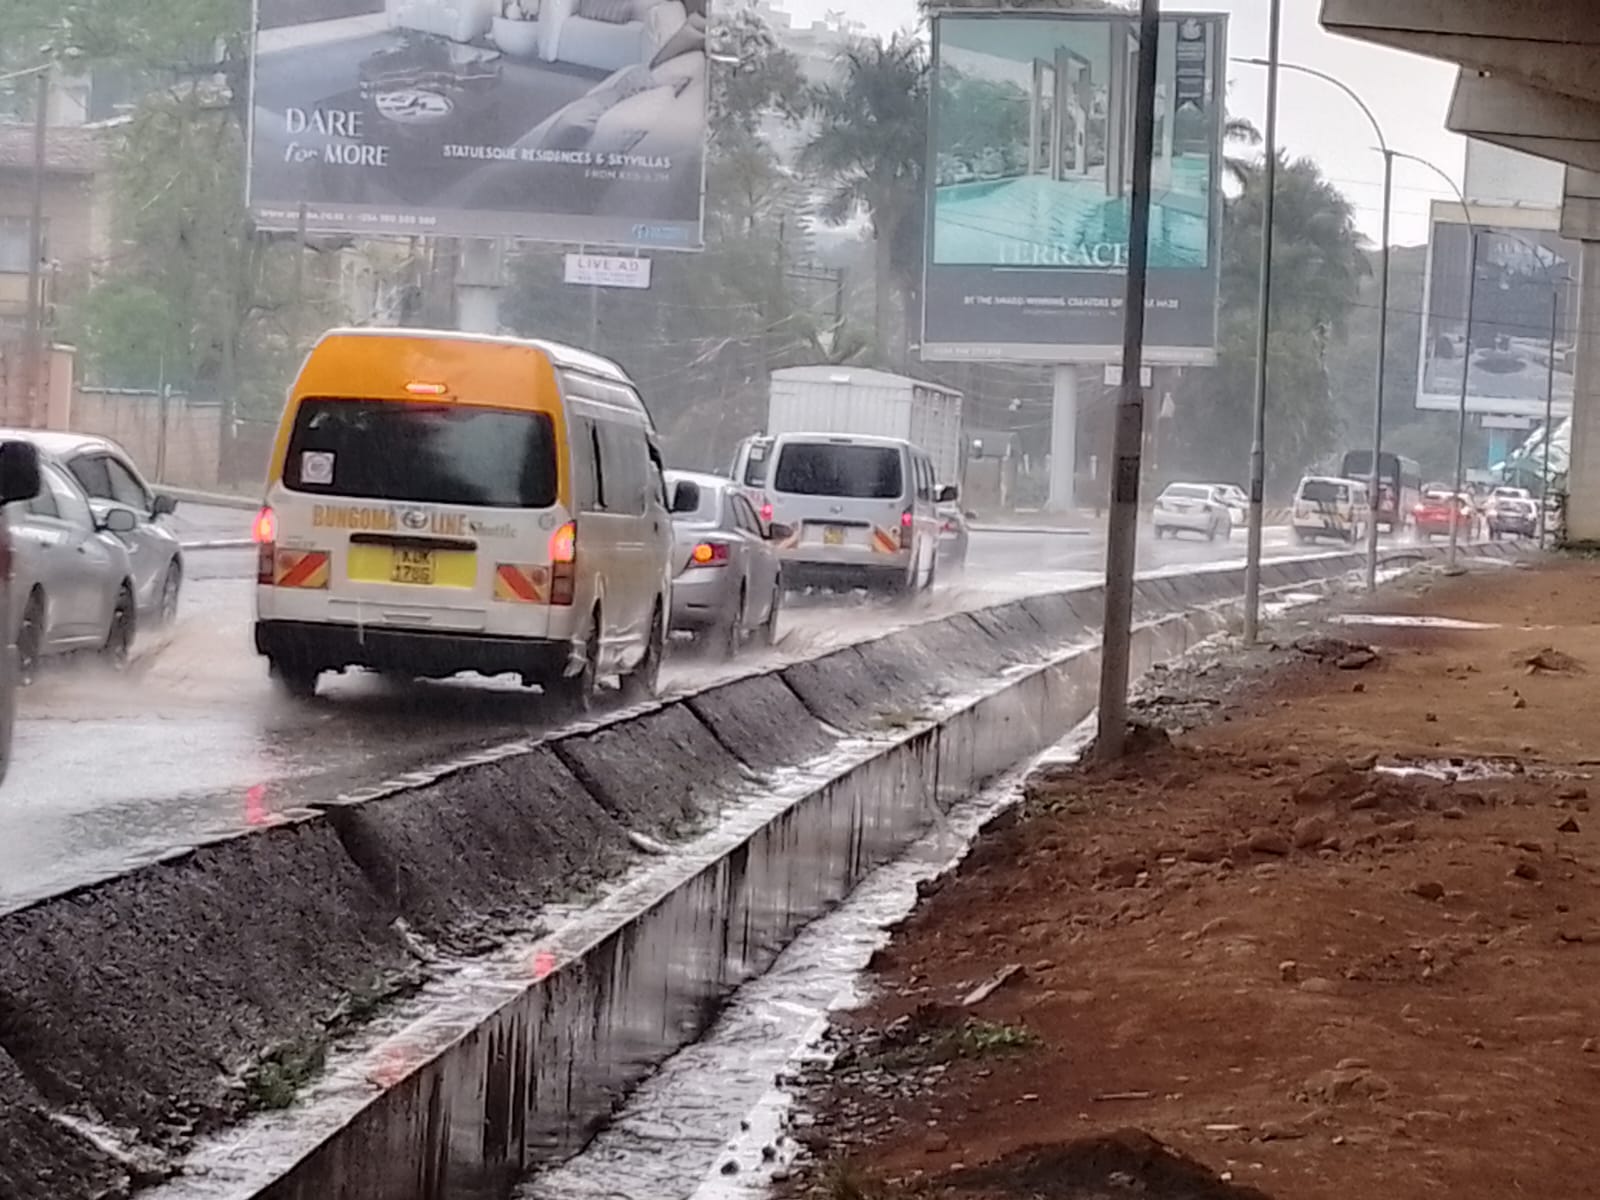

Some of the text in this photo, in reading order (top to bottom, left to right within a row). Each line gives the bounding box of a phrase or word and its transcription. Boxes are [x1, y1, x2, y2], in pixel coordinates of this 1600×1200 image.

[286, 107, 364, 137] DARE
[284, 141, 390, 167] for MORE
[442, 144, 516, 161] STATUESQUE
[521, 147, 592, 165] RESIDENCES
[608, 152, 672, 168] SKYVILLAS
[577, 258, 639, 271] LIVE AD
[312, 504, 398, 530] BUNGOMA
[431, 510, 468, 536] LINE
